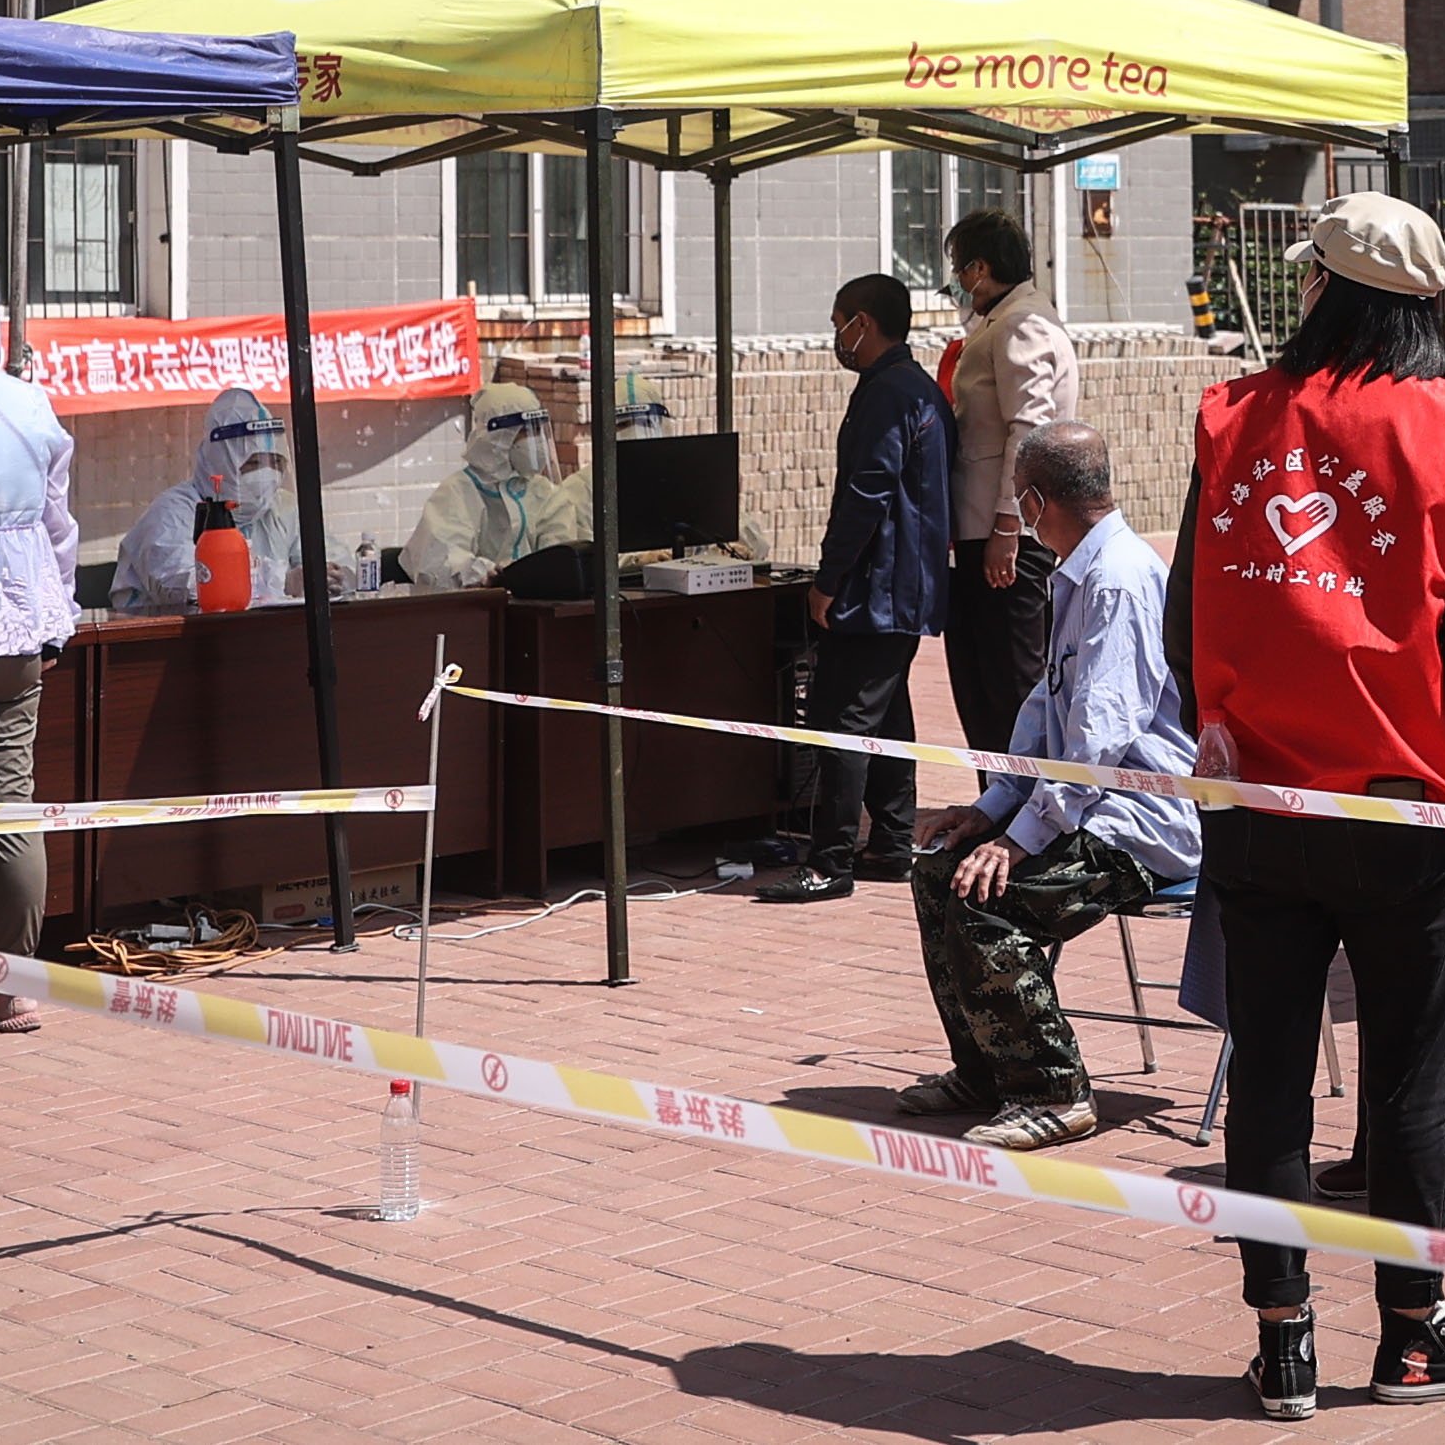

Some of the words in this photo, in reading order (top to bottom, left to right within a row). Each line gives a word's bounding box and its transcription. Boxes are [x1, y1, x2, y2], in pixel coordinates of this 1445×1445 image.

[905, 41, 962, 90] be
[974, 54, 1091, 92] more
[1101, 52, 1168, 97] tea
[1223, 561, 1365, 597] 一小时工作站
